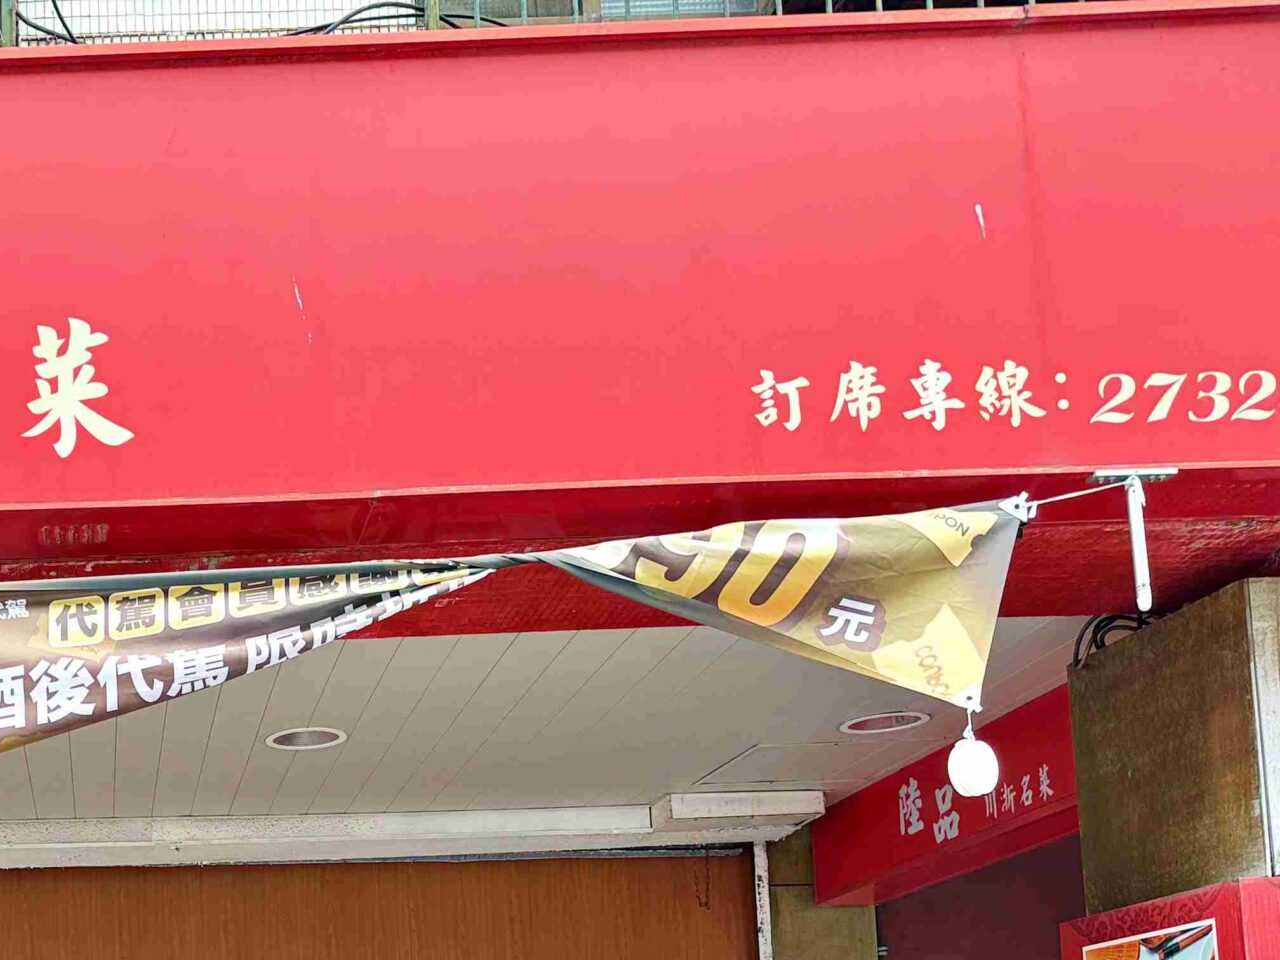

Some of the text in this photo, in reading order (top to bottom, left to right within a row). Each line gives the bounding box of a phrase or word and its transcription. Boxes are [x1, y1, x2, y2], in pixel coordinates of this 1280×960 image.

[820, 597, 877, 644] 元
[898, 777, 961, 844] 陸品
[984, 764, 1055, 820] 川浙名菜
